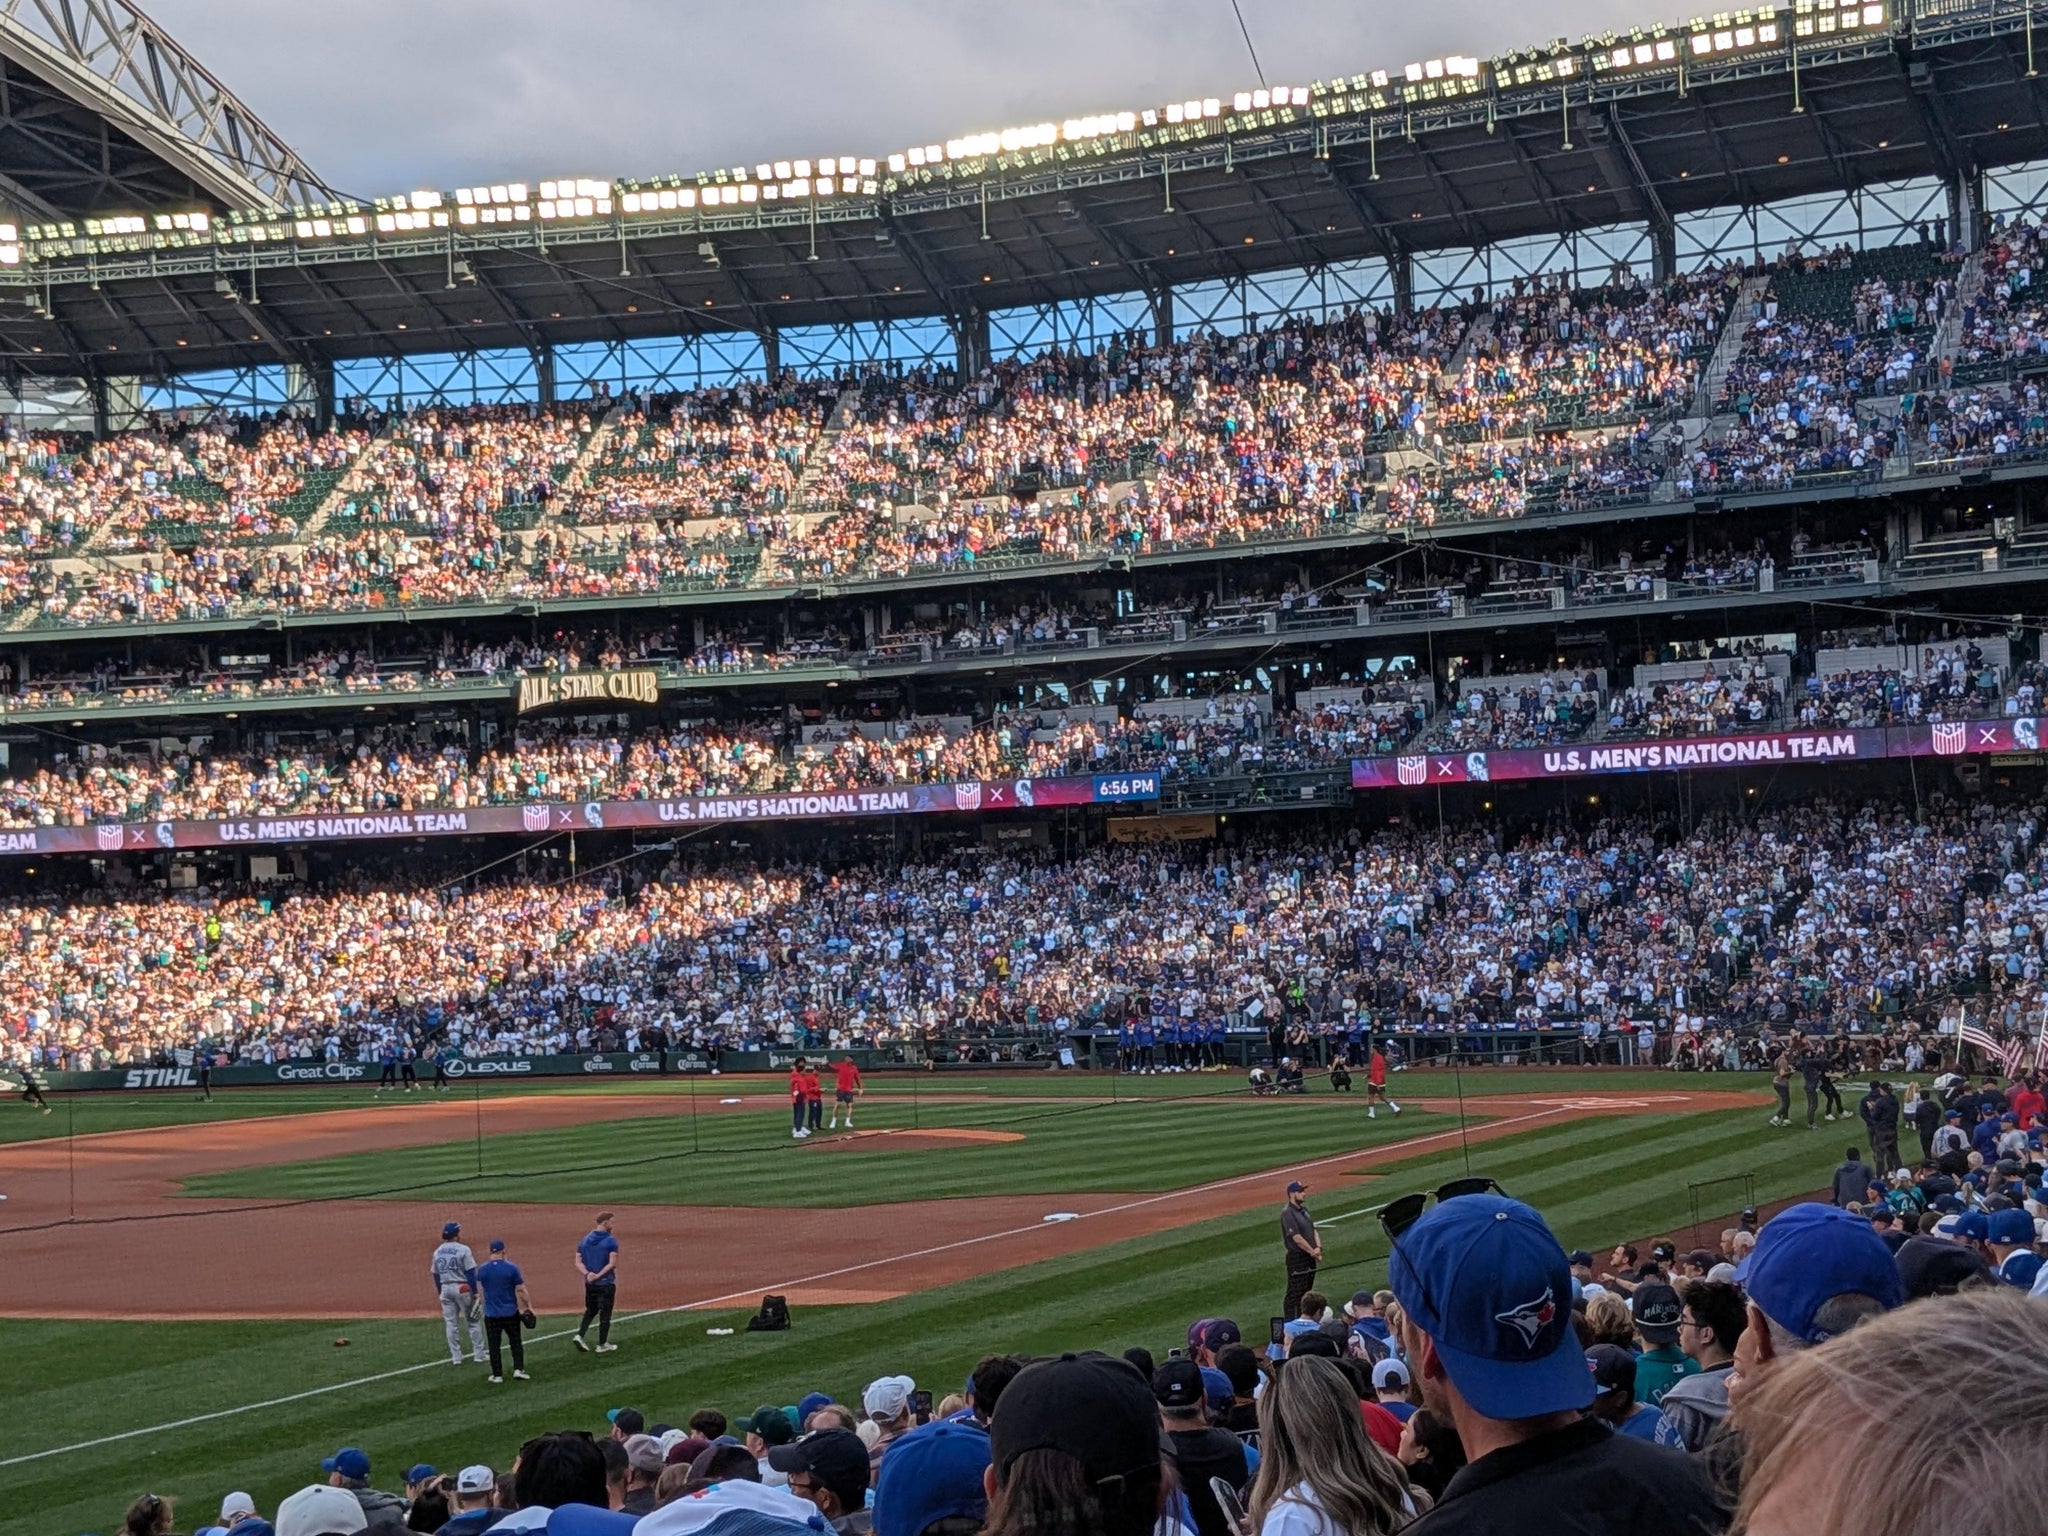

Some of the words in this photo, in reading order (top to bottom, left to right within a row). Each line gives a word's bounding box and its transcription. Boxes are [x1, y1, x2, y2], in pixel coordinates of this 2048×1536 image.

[518, 677, 553, 716] ALL
[560, 675, 608, 700] STAR
[608, 671, 658, 703] CLUB
[1544, 752, 1587, 772] U.S.
[1589, 746, 1661, 769] MEN'S
[1664, 739, 1785, 765] NATIONAL
[1787, 735, 1856, 758] TEAM
[1100, 780, 1129, 796] 6:56
[1132, 778, 1154, 794] PM
[658, 803, 696, 821] U.S.
[698, 800, 758, 819] MEN'S
[761, 794, 858, 816] NATIONAL
[858, 791, 909, 811] TEAM
[219, 823, 256, 841] U.S.
[257, 820, 316, 839] MEN'S
[318, 816, 413, 838] NATIONAL
[414, 813, 468, 832] TEAM
[0, 833, 38, 851] EAM
[277, 1064, 323, 1080] Great
[325, 1063, 363, 1081] Clips
[467, 1061, 532, 1073] LEXUS
[583, 1060, 613, 1072] Corona
[630, 1060, 660, 1071] Corona
[677, 1059, 707, 1071] Corona
[124, 1068, 198, 1088] STIHL
